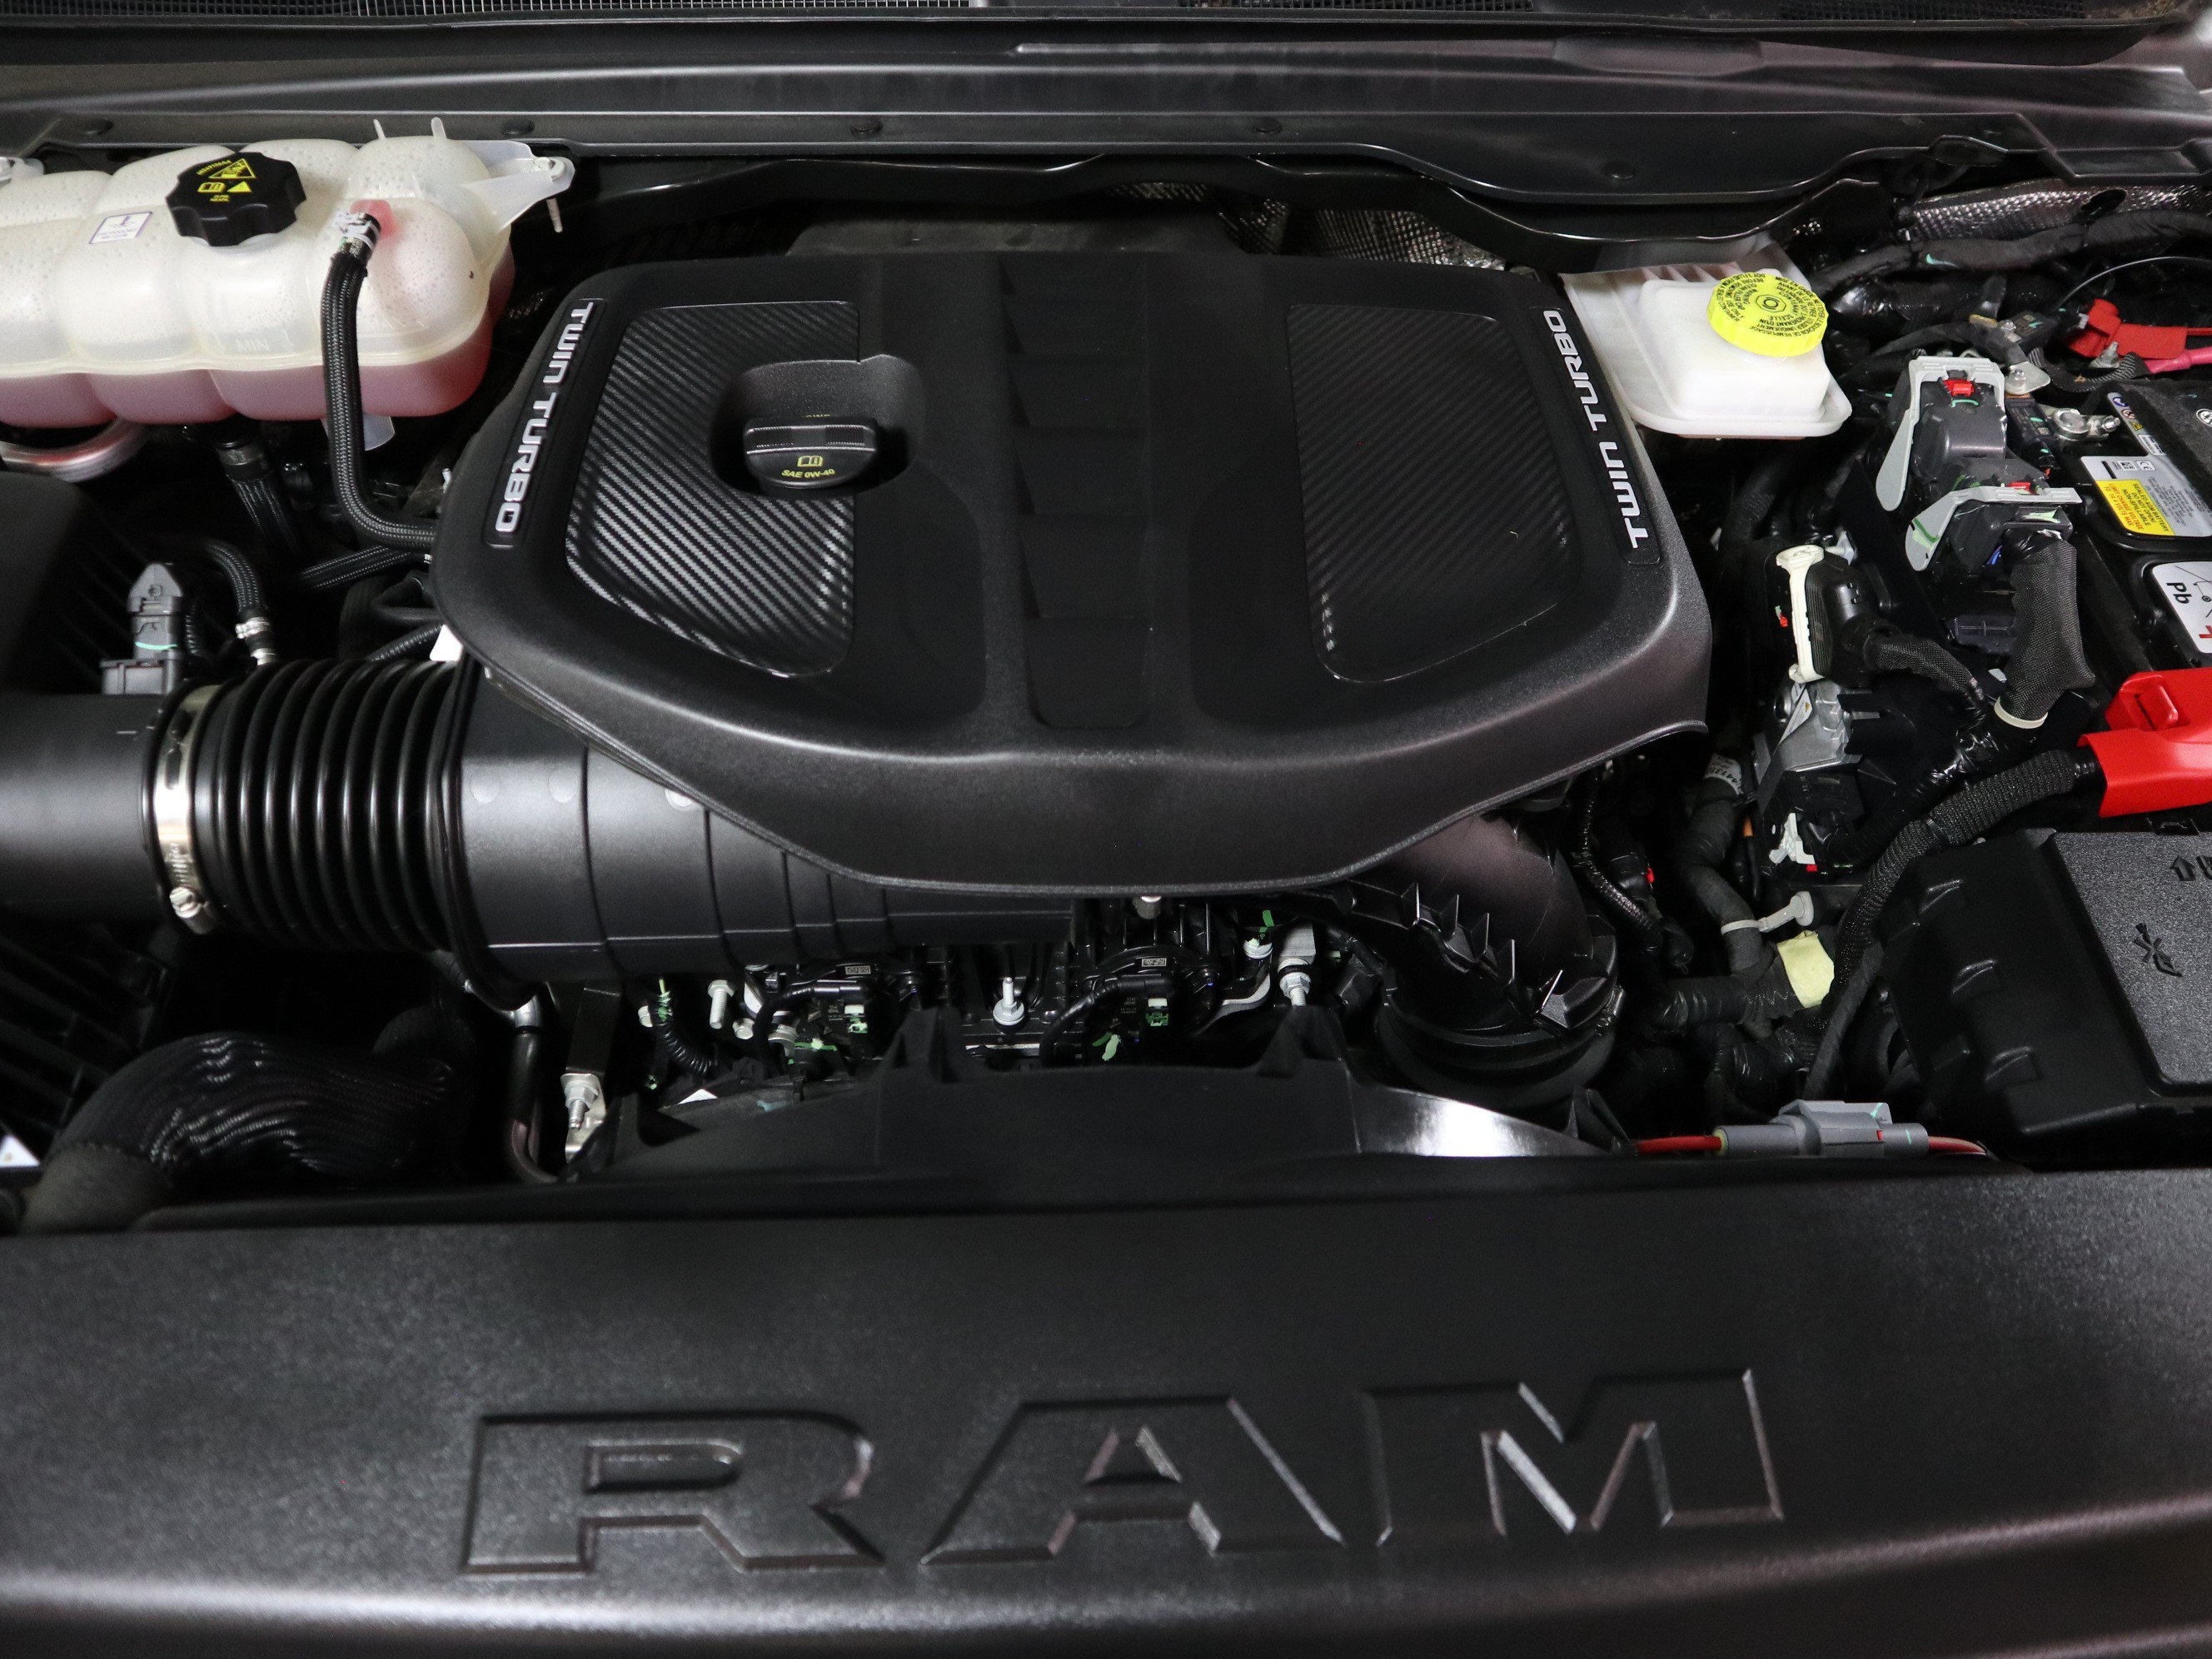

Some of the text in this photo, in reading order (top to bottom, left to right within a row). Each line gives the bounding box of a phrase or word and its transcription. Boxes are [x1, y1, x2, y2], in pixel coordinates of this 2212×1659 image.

[1778, 282, 1797, 291] AVANT
[495, 301, 594, 532] TWIN TURBO
[1543, 310, 1649, 549] TWIN TURBO
[781, 468, 836, 478] SAE 0W-40
[2117, 495, 2132, 511] CHARGE
[2128, 512, 2145, 530] VOLTAGE
[2122, 489, 2151, 526] NON-SPILLABLE
[2132, 483, 2149, 501] SEALED
[2152, 511, 2170, 531] BATTERY
[2166, 582, 2192, 605] Pb
[458, 1368, 1786, 1575] RAM
